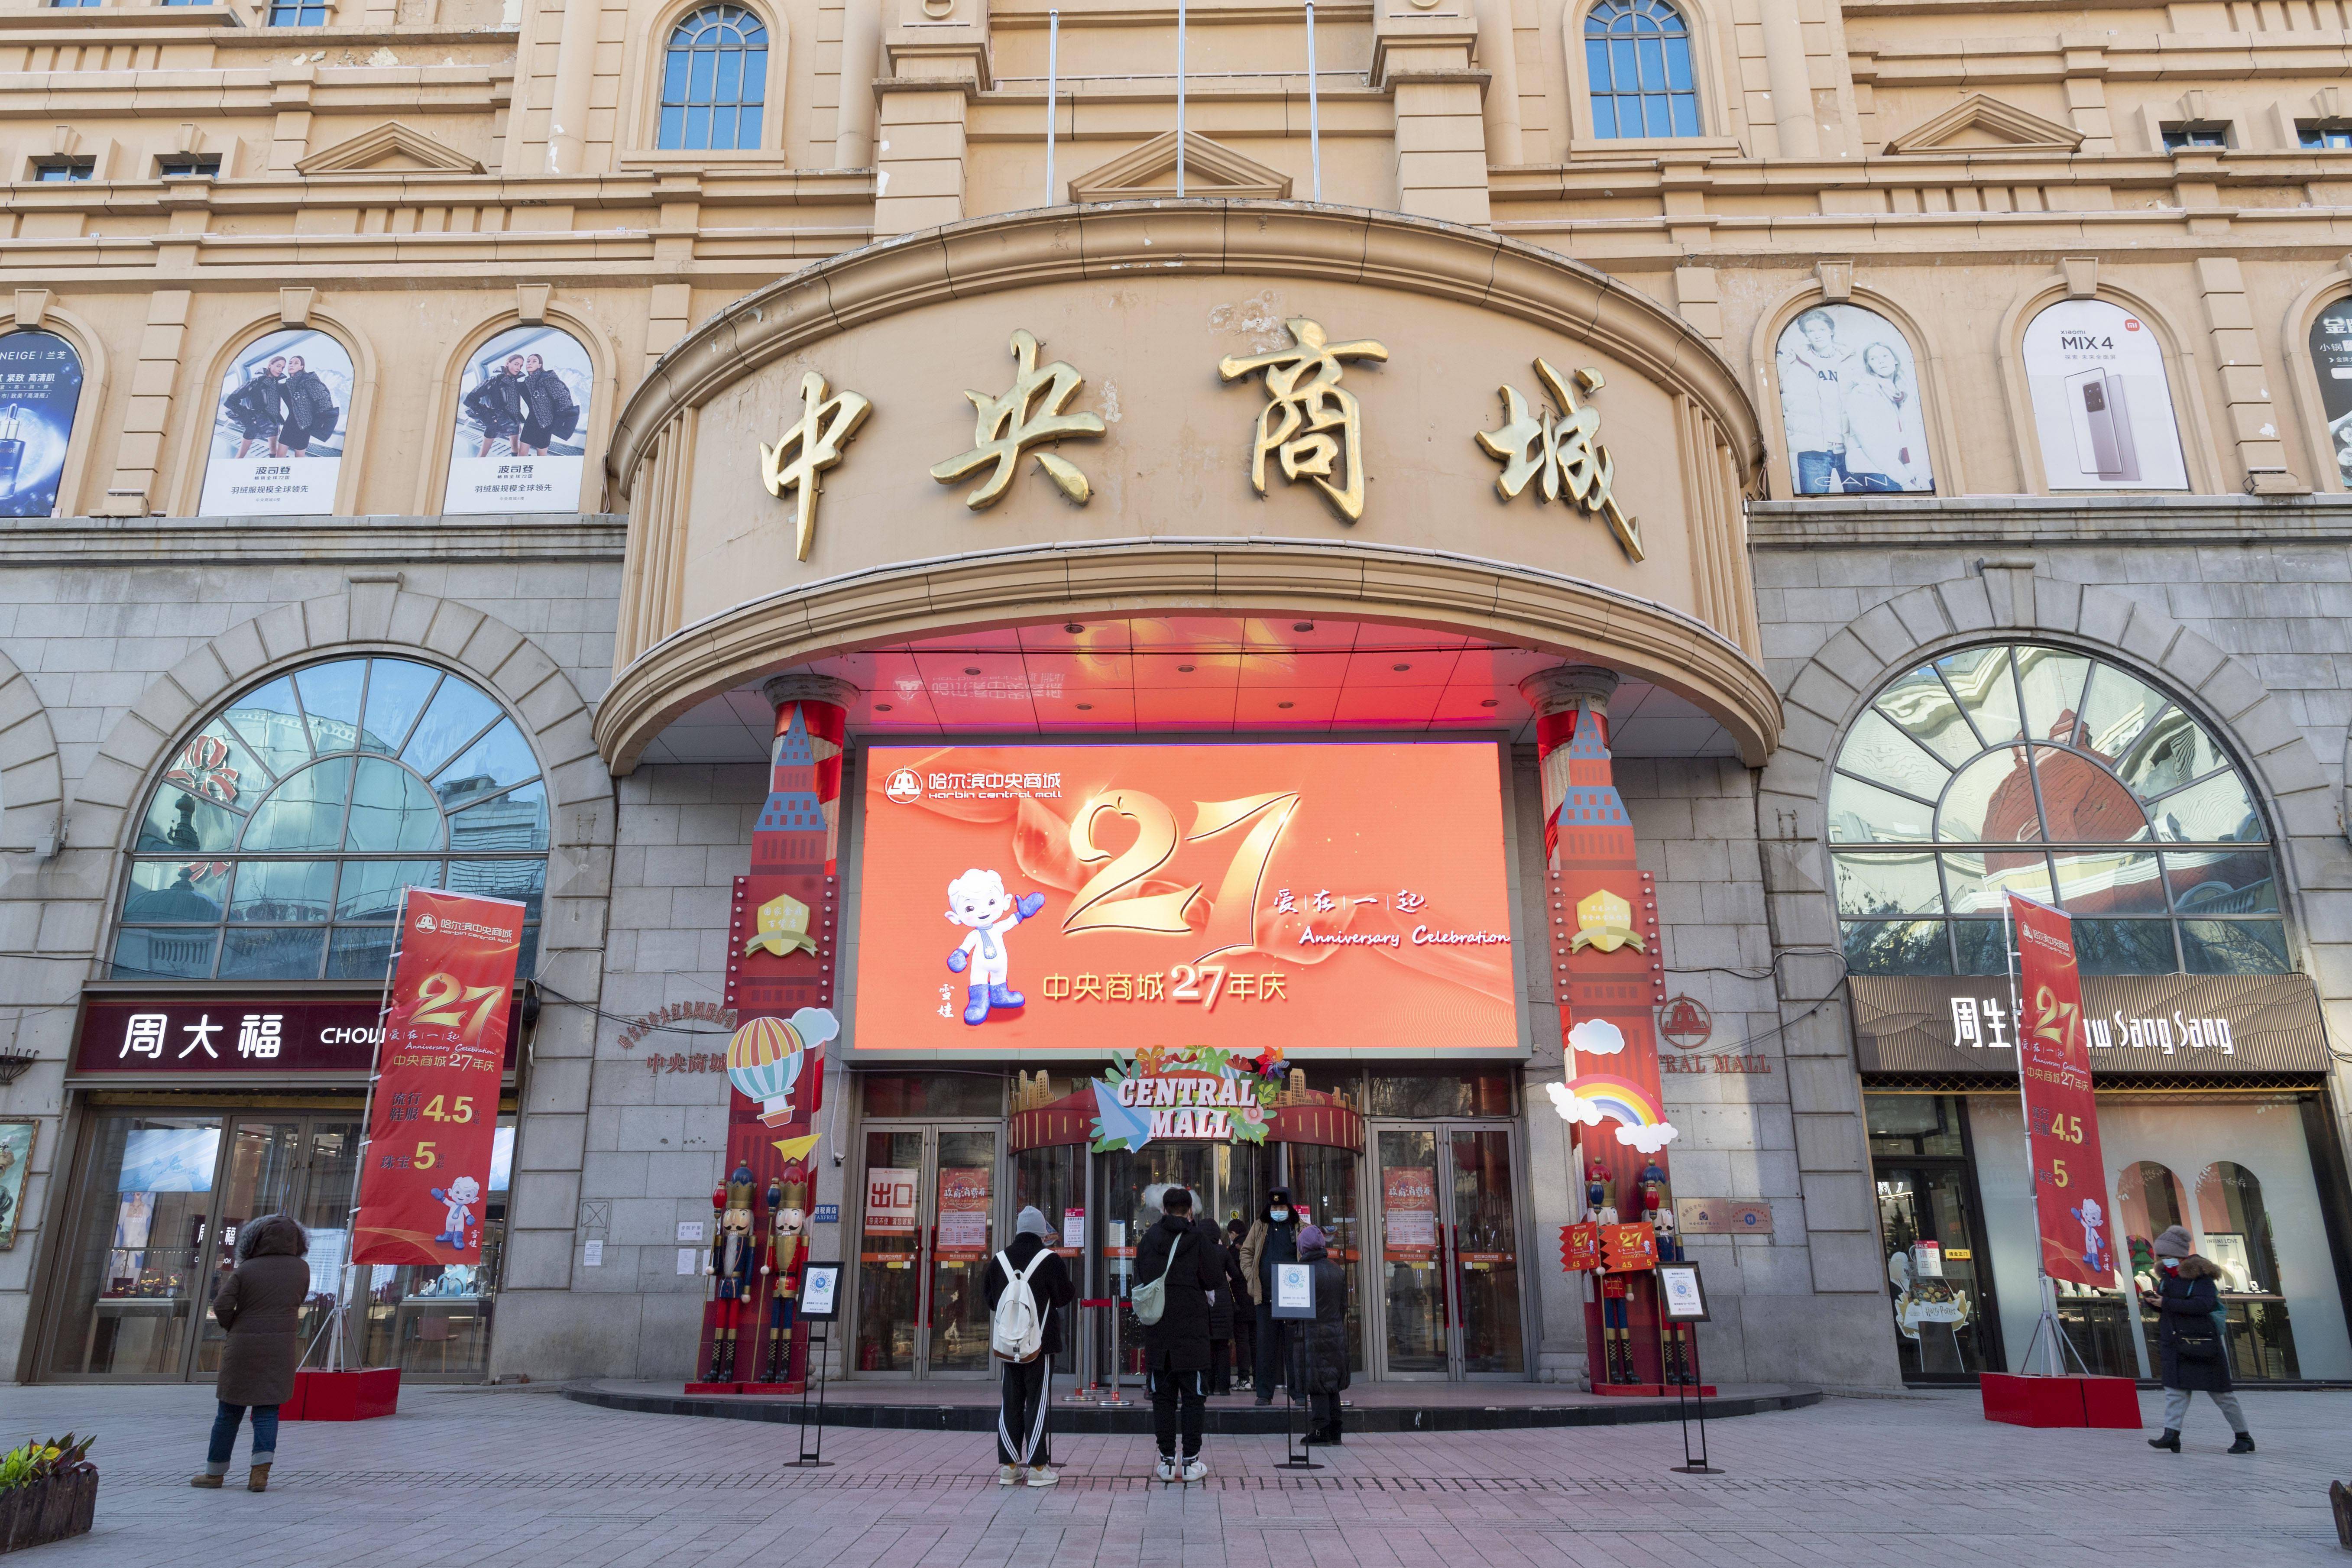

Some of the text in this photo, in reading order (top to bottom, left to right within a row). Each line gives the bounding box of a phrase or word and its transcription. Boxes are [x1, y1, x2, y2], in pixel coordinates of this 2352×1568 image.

[2061, 336, 2114, 350] MIX 4
[46, 351, 66, 360] 兰芝
[28, 373, 55, 382] 高清肌
[759, 317, 1645, 563] 中央商城
[256, 466, 291, 475] 波司登
[498, 465, 534, 473] 波司登
[231, 485, 309, 494] 羽绒服规模全球领先
[474, 484, 552, 493] 羽绒服规模全球领先
[928, 772, 1061, 790] 哈尔滨中央商城
[928, 790, 975, 799] Harbin
[1035, 790, 1063, 799] mall
[441, 919, 513, 939] 哈尔滨中央商城
[1299, 925, 1512, 947] Anniversary Celebration
[2033, 928, 2070, 952] 哈尔滨中央商城
[408, 972, 505, 1053] 27
[2032, 985, 2078, 1059] 27
[617, 1001, 737, 1050] 哈尔滨中央红集团股份有
[1950, 997, 2022, 1048] 周生
[119, 1013, 284, 1059] 周大福
[2114, 1010, 2174, 1055] Sang
[2174, 1010, 2235, 1055] Sang
[405, 1040, 450, 1053] Anniversary
[646, 1053, 729, 1074] 中央商城
[1714, 1054, 1771, 1073] MALL
[392, 1092, 422, 1107] 流行
[1116, 1077, 1257, 1110] CENTRAL
[389, 1107, 420, 1122] 鞋服
[422, 1094, 474, 1124] 4.5
[1147, 1106, 1234, 1141] MALL
[2051, 1113, 2083, 1144] 4.5
[380, 1155, 412, 1170] 珠宝
[414, 1141, 436, 1170] 5
[2054, 1159, 2069, 1188] 5
[871, 1182, 913, 1208] 出口
[1620, 1231, 1642, 1247] 27
[1919, 1250, 1937, 1259] 请走
[1921, 1261, 1938, 1269] 正门
[1925, 1305, 1957, 1317] Harry Potter
